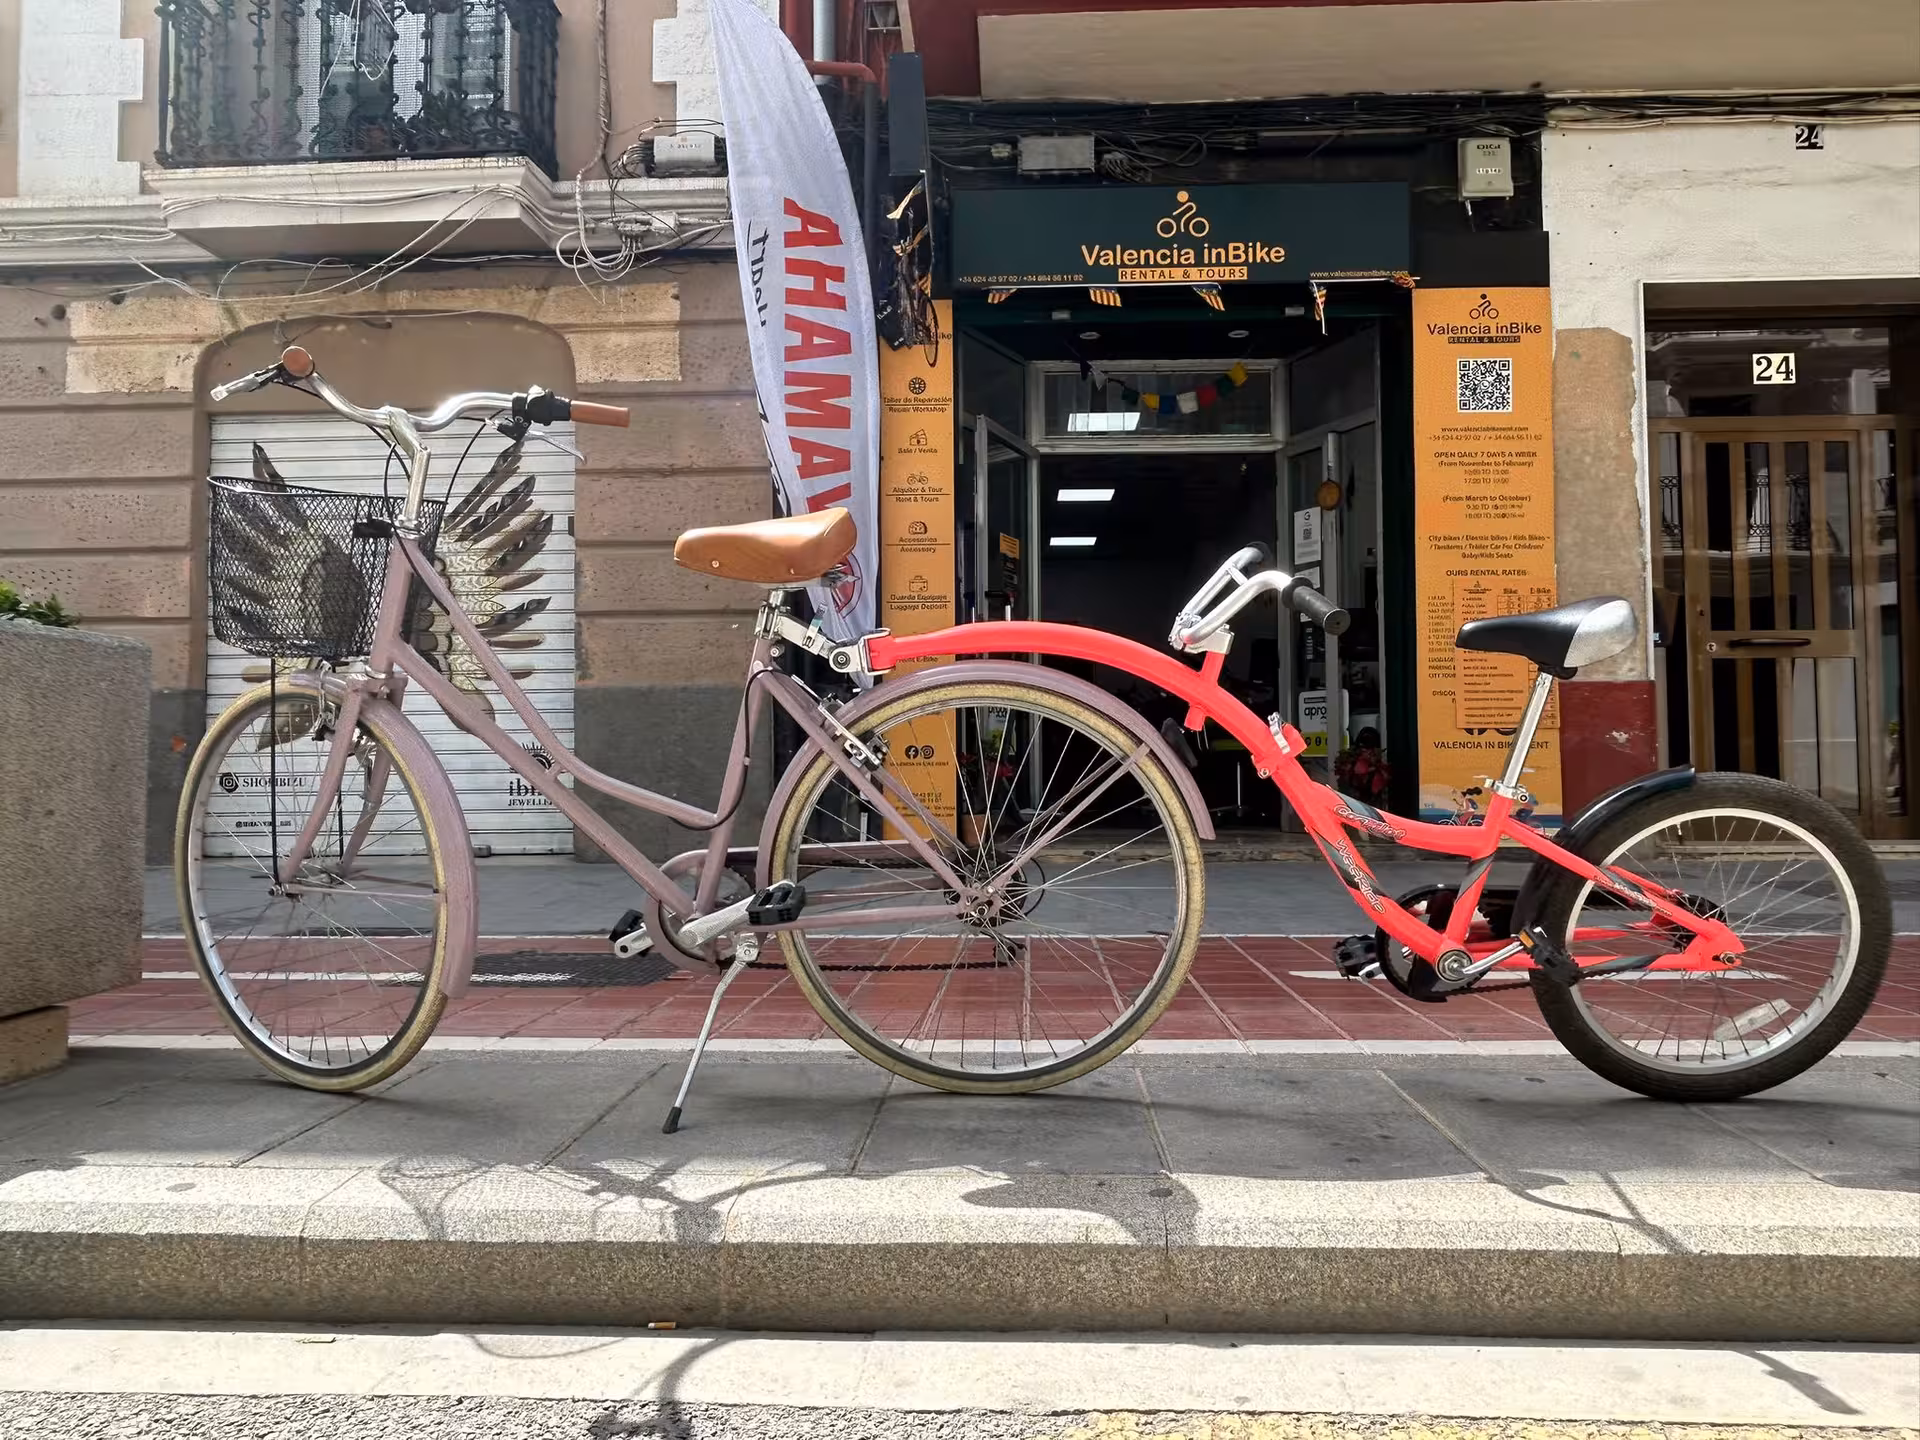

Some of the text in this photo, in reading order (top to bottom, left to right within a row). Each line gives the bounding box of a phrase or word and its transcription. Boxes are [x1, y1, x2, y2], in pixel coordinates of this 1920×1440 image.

[1795, 125, 1823, 147] 24
[1081, 241, 1286, 266] Valencia inBike
[1120, 268, 1246, 280] RENTAL & TOURS
[1427, 322, 1542, 336] Valencia inBike
[1755, 355, 1794, 382] 24
[1433, 741, 1481, 749] VALENCIA
[1530, 740, 1550, 748] ENT
